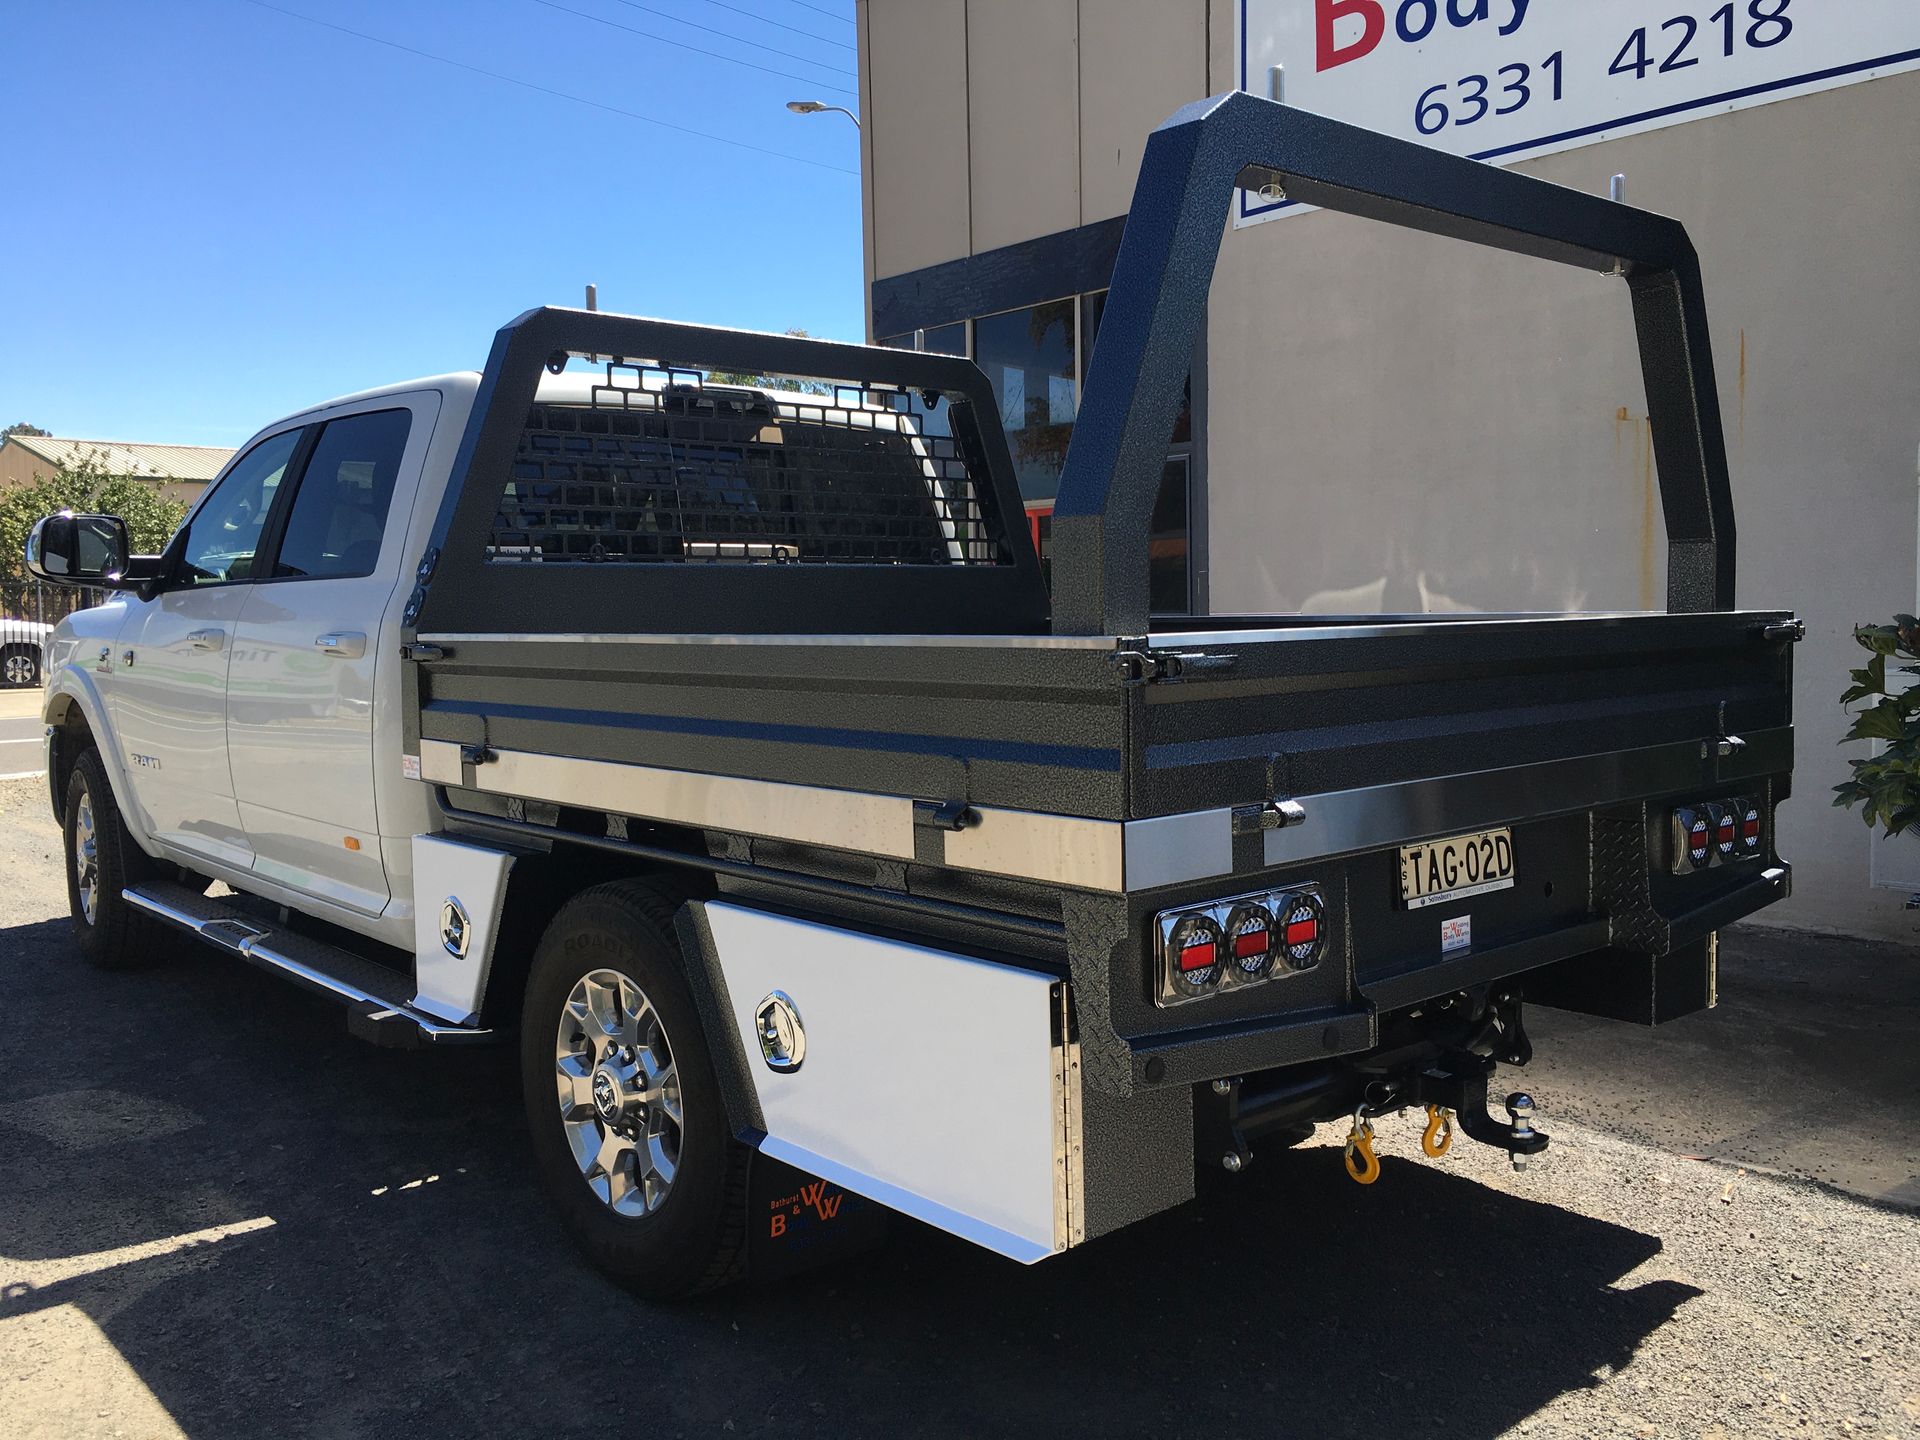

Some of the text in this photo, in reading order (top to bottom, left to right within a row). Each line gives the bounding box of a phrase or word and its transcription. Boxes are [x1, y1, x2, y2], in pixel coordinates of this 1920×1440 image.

[1414, 0, 1794, 135] 6331 4218
[131, 753, 161, 770] RAM
[770, 1194, 799, 1210] Bathurst
